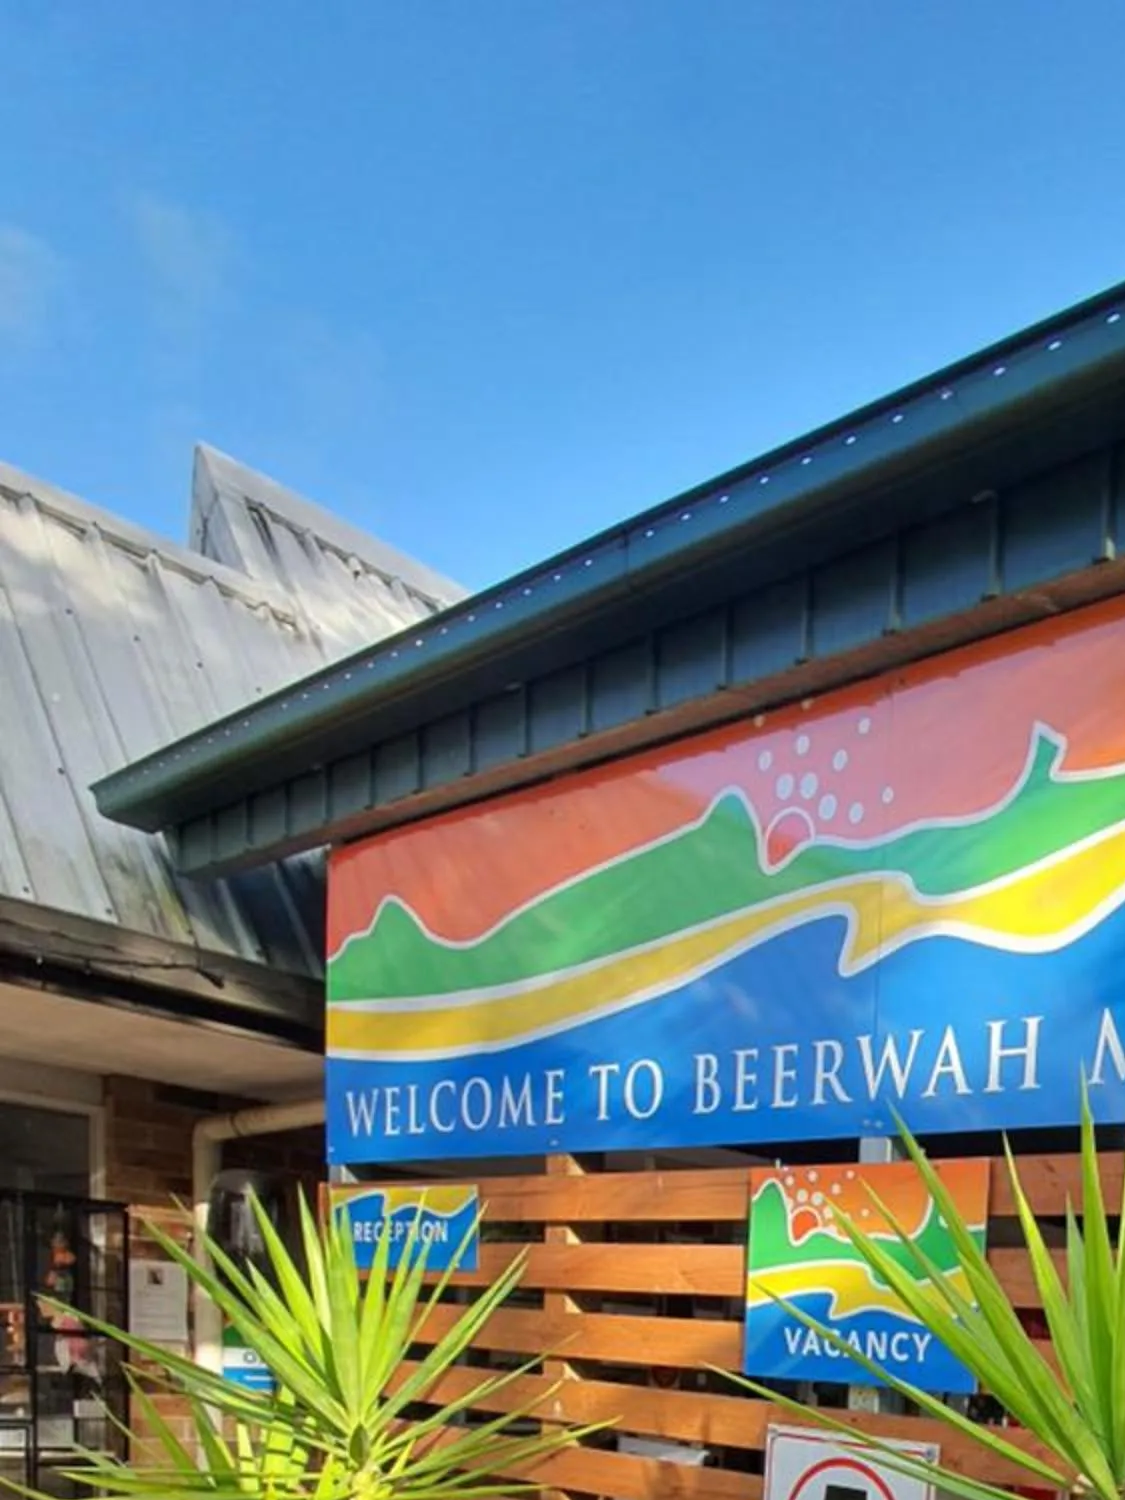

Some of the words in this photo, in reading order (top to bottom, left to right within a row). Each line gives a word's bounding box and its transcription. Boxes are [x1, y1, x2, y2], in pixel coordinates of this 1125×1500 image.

[346, 1069, 566, 1137] WELCOME
[588, 1058, 663, 1122] TO
[692, 1015, 1044, 1115] BEERWAH
[353, 1220, 449, 1243] RECPON
[783, 1326, 932, 1363] VACANCY
